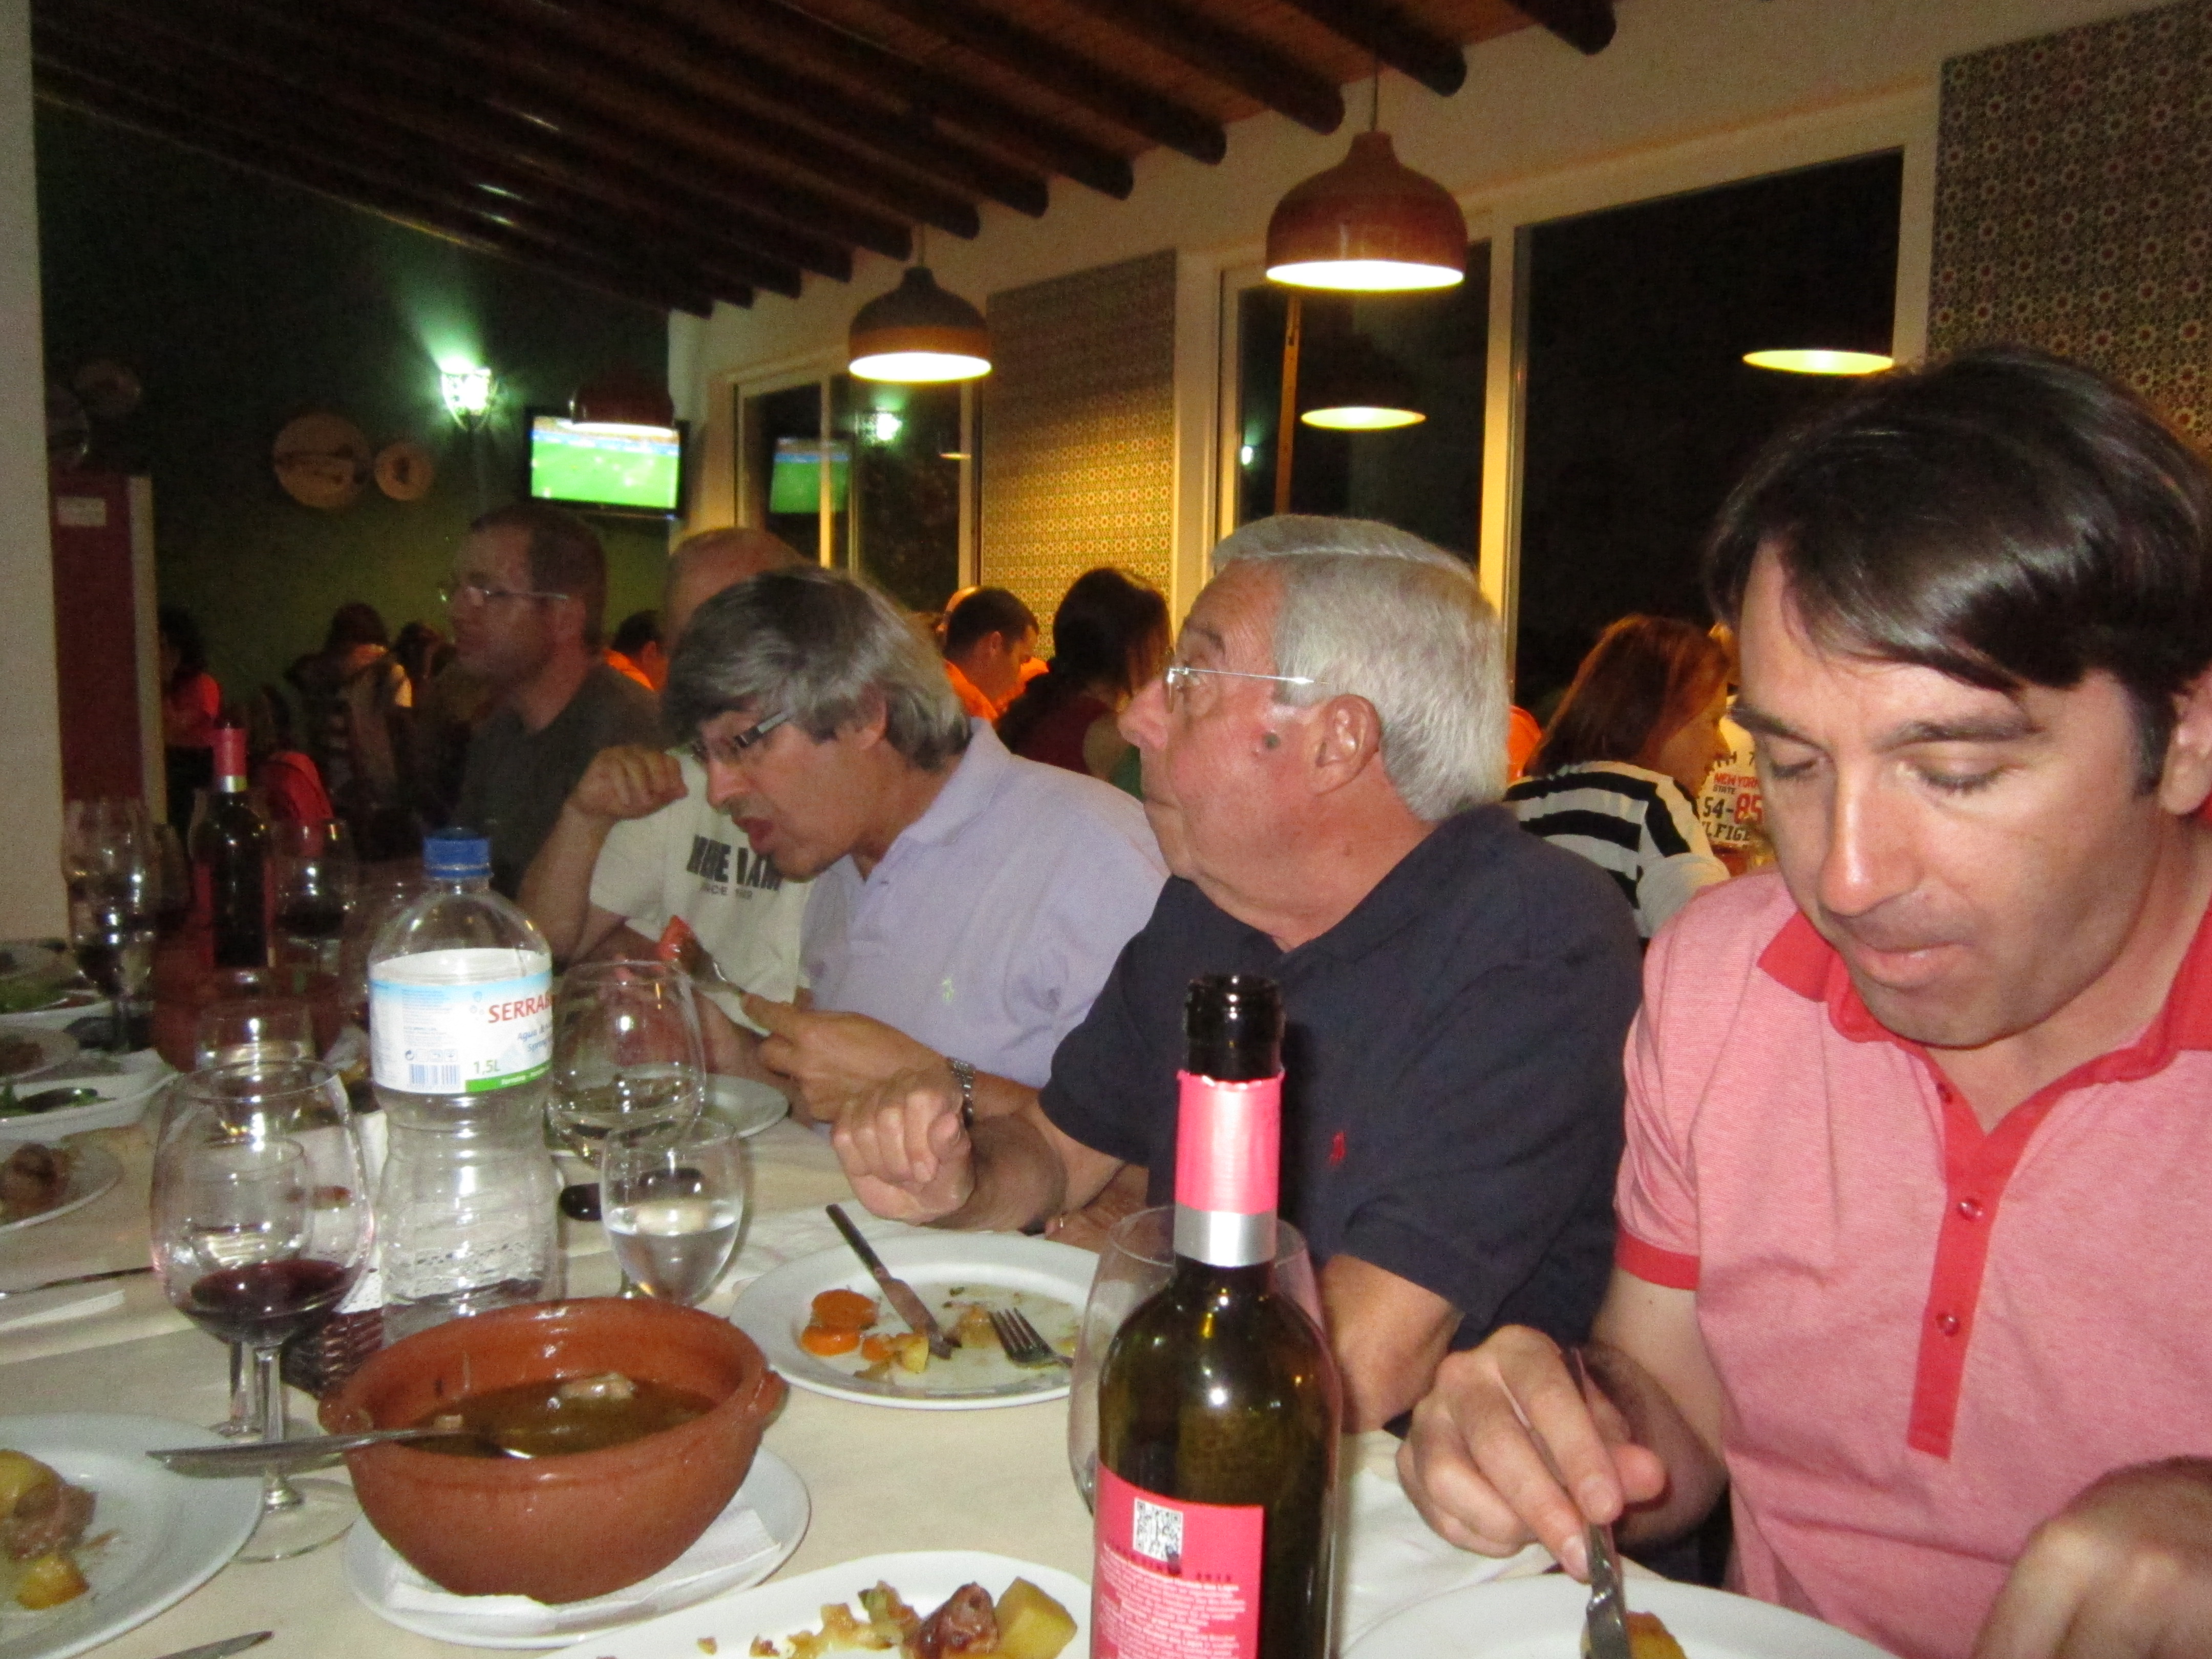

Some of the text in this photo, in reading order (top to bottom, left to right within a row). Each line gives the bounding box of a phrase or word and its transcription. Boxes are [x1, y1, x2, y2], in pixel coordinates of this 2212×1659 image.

[1714, 773, 1736, 785] NEW
[1713, 785, 1736, 794] STATE
[473, 1058, 501, 1076] 1,5L
